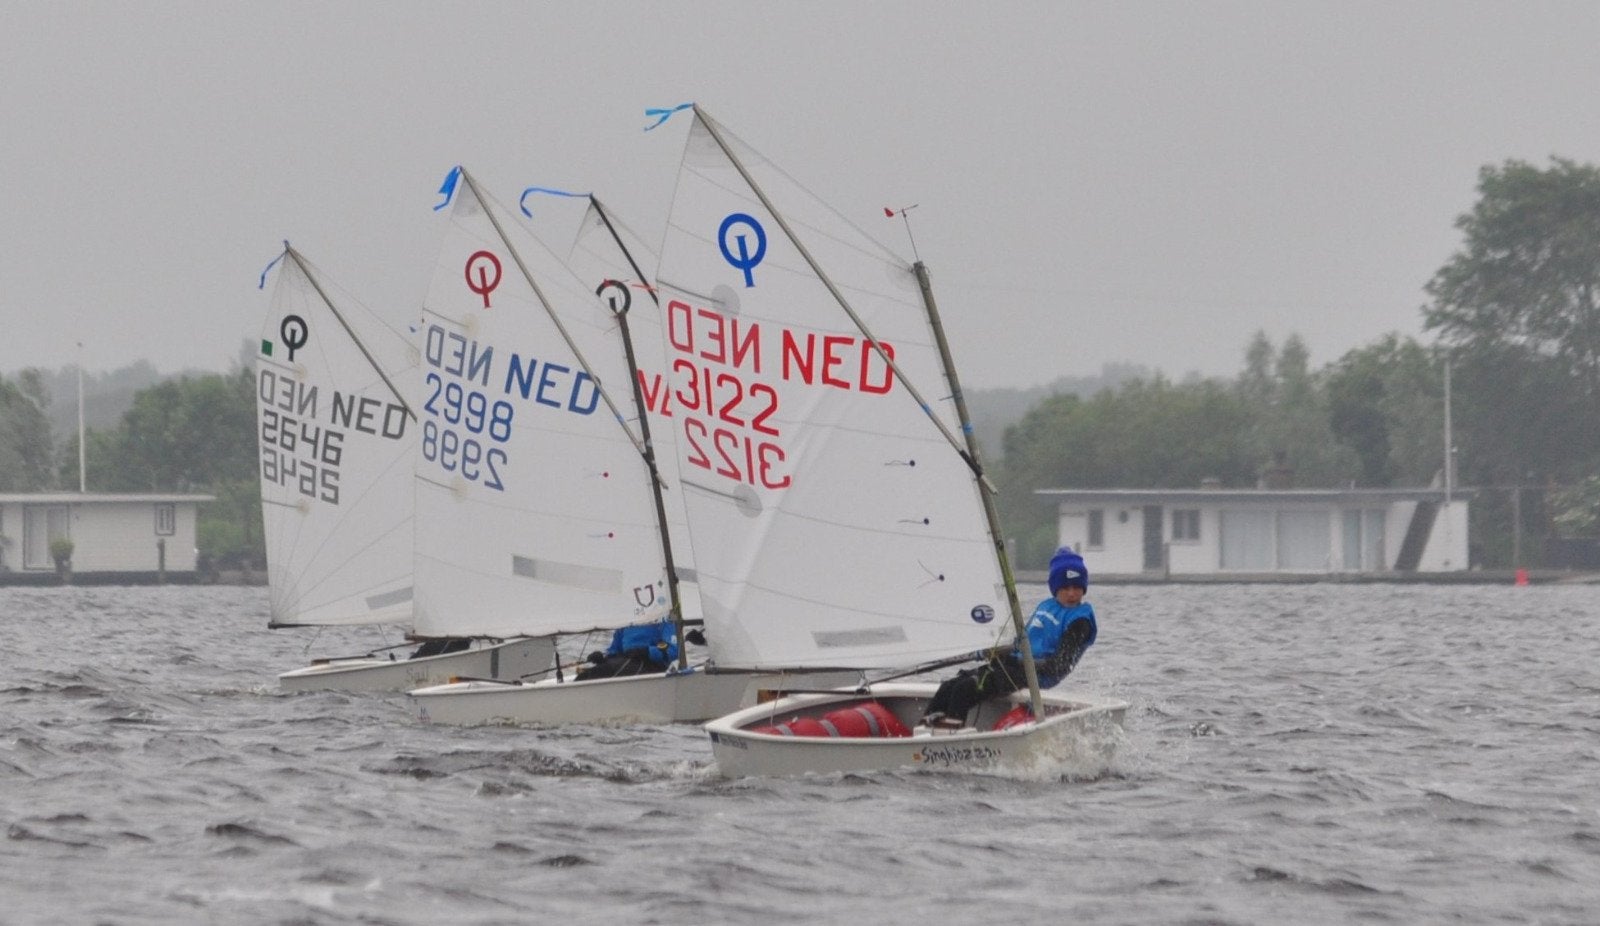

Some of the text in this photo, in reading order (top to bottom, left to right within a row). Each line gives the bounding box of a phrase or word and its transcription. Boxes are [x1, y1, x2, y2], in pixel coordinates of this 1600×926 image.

[504, 353, 602, 416] NED
[782, 329, 896, 395] NED
[331, 391, 408, 440] NED
[424, 372, 514, 443] 2998
[673, 358, 780, 437] 3122
[262, 408, 345, 467] 2646
